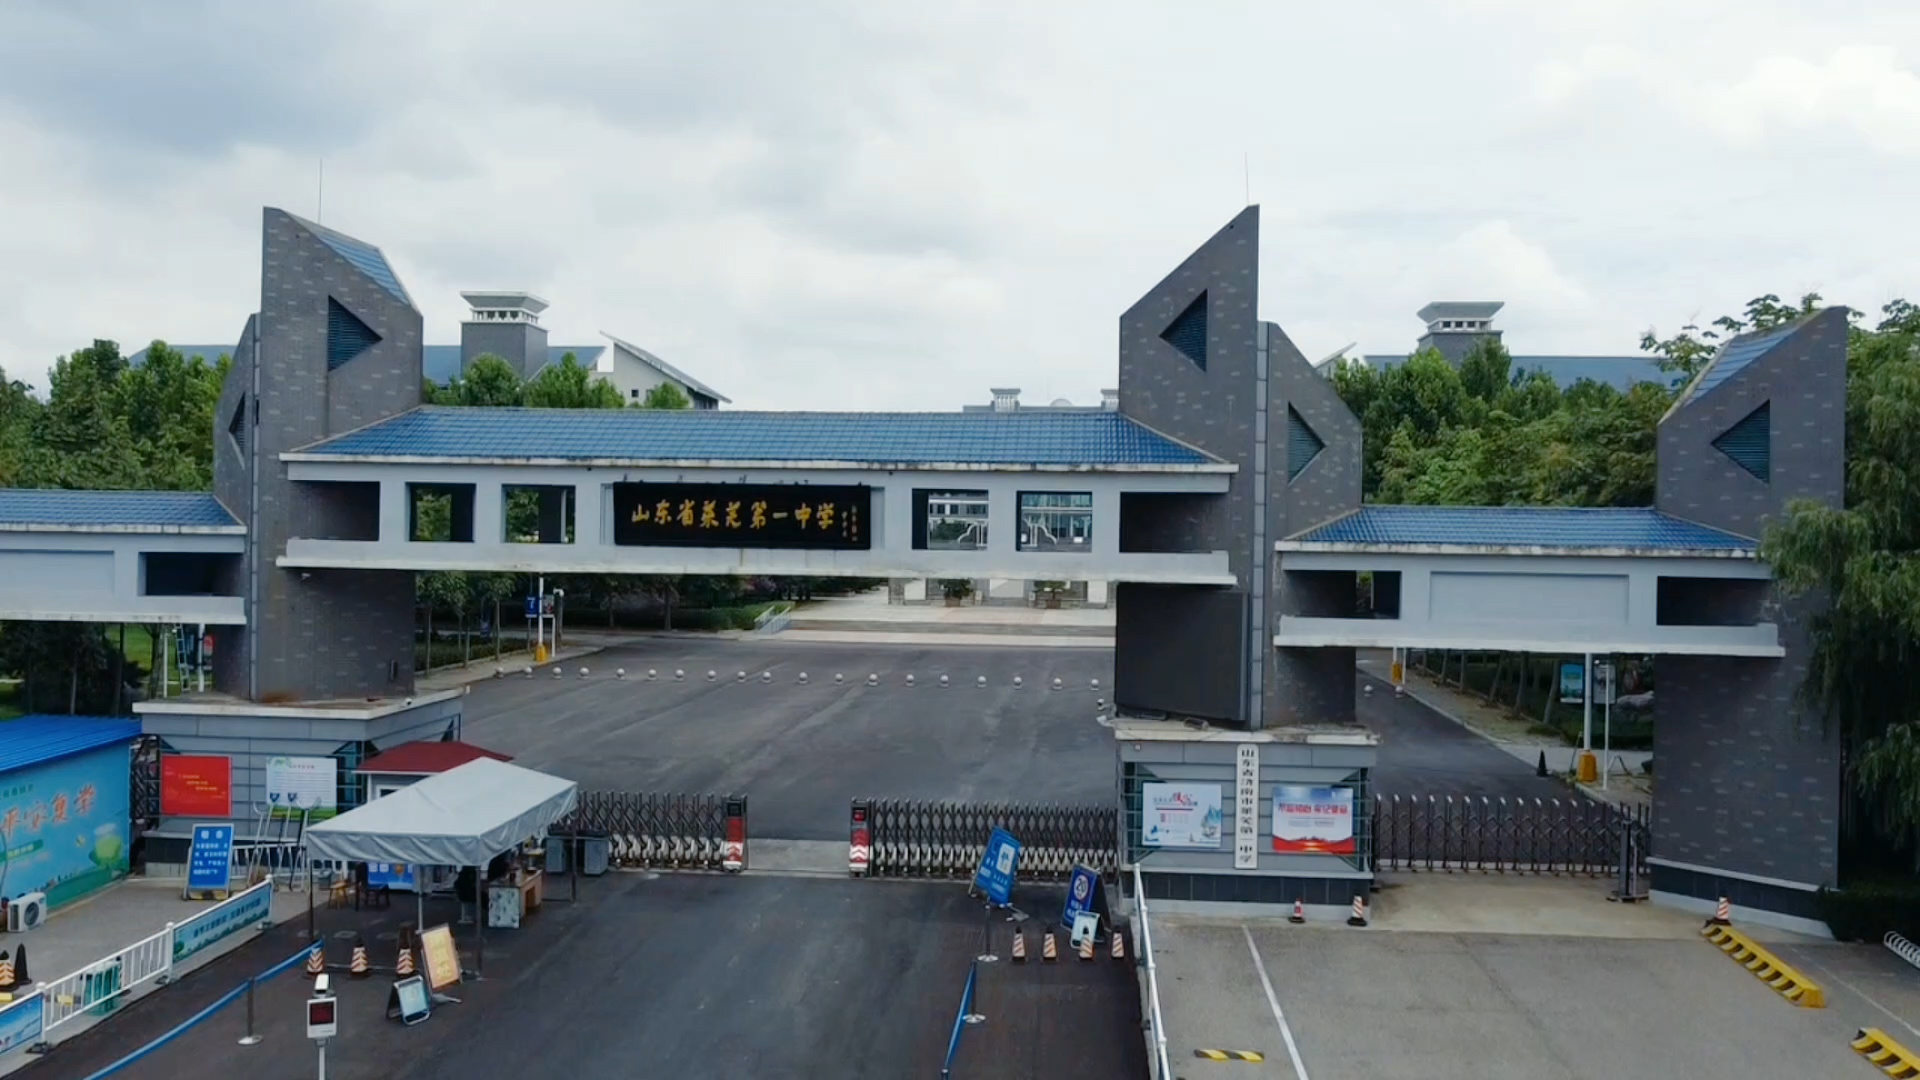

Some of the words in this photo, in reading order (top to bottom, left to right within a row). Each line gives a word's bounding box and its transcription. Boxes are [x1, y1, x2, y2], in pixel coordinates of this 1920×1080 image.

[631, 498, 835, 530] 山东省莱芜第一中学
